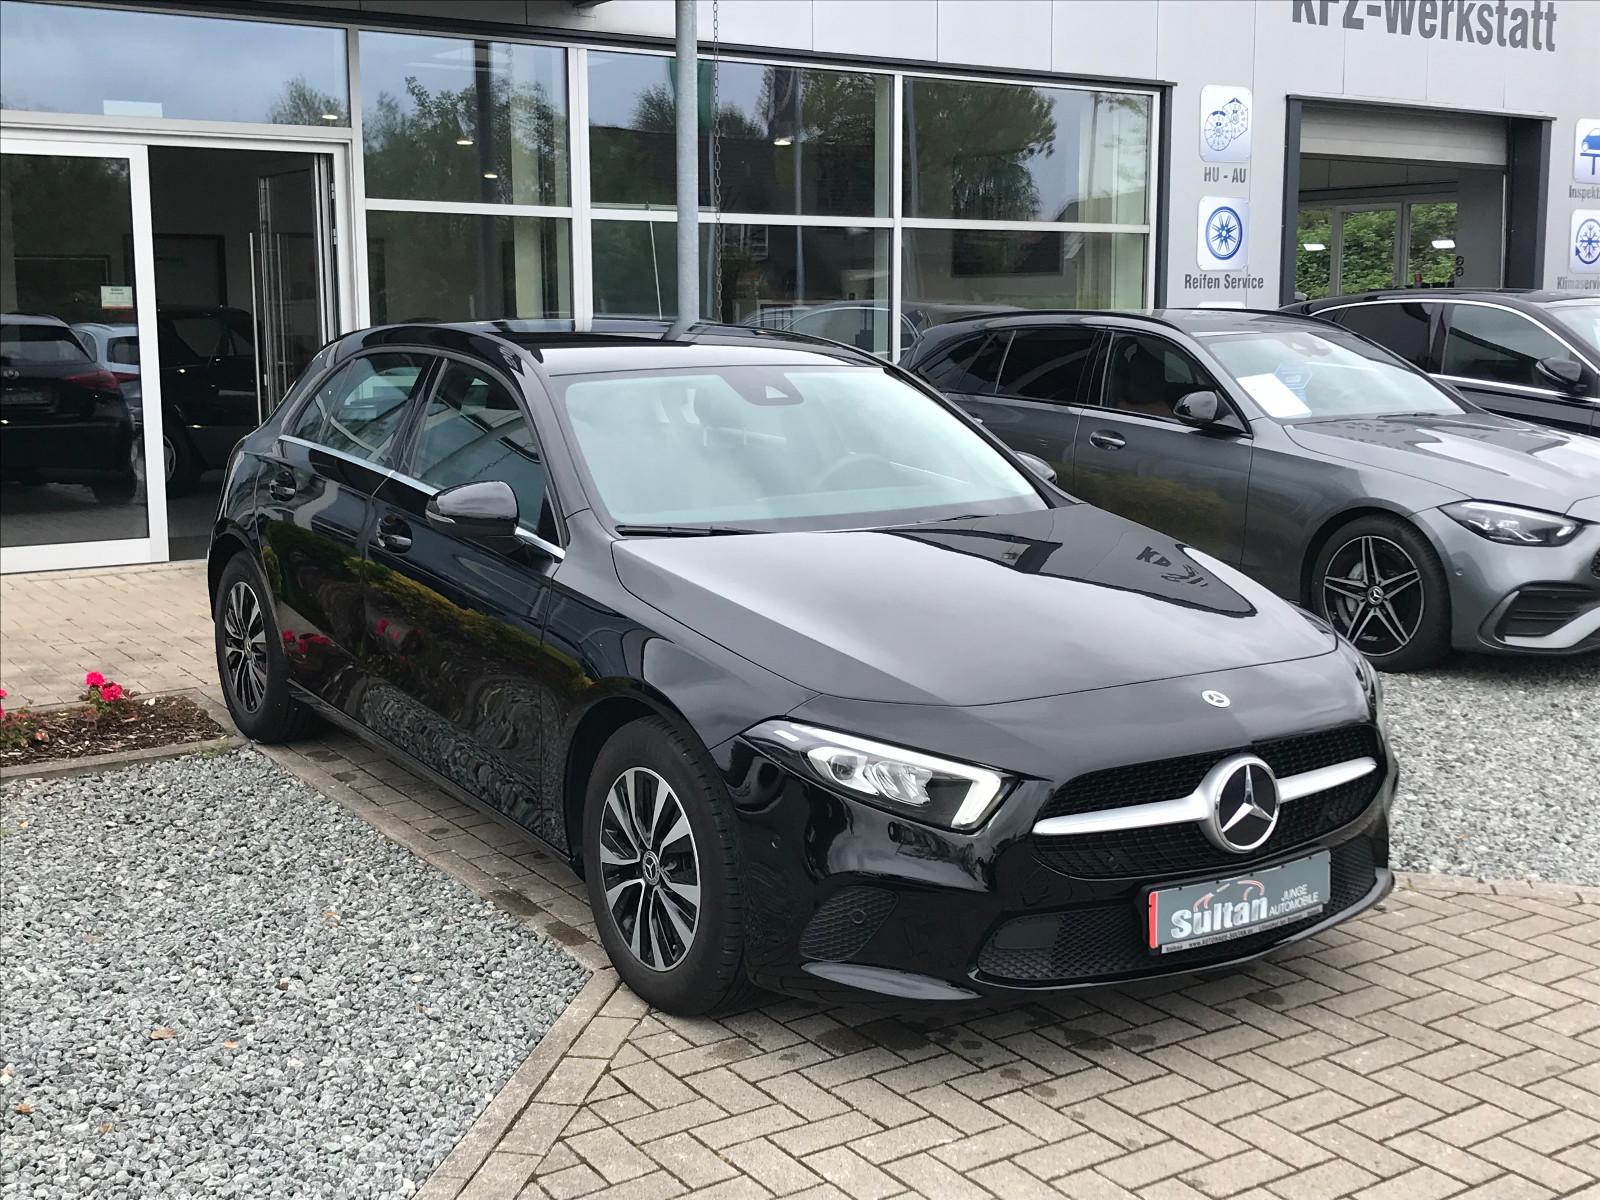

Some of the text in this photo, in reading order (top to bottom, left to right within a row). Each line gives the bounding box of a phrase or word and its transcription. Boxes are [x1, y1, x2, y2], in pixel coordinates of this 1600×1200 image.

[1203, 166, 1220, 183] HU
[1231, 167, 1247, 184] AU
[1184, 273, 1264, 289] Reifen Service
[1280, 883, 1308, 902] JUNGE
[1268, 891, 1319, 917] AUTOMOBILE
[1170, 896, 1268, 939] Sultan
